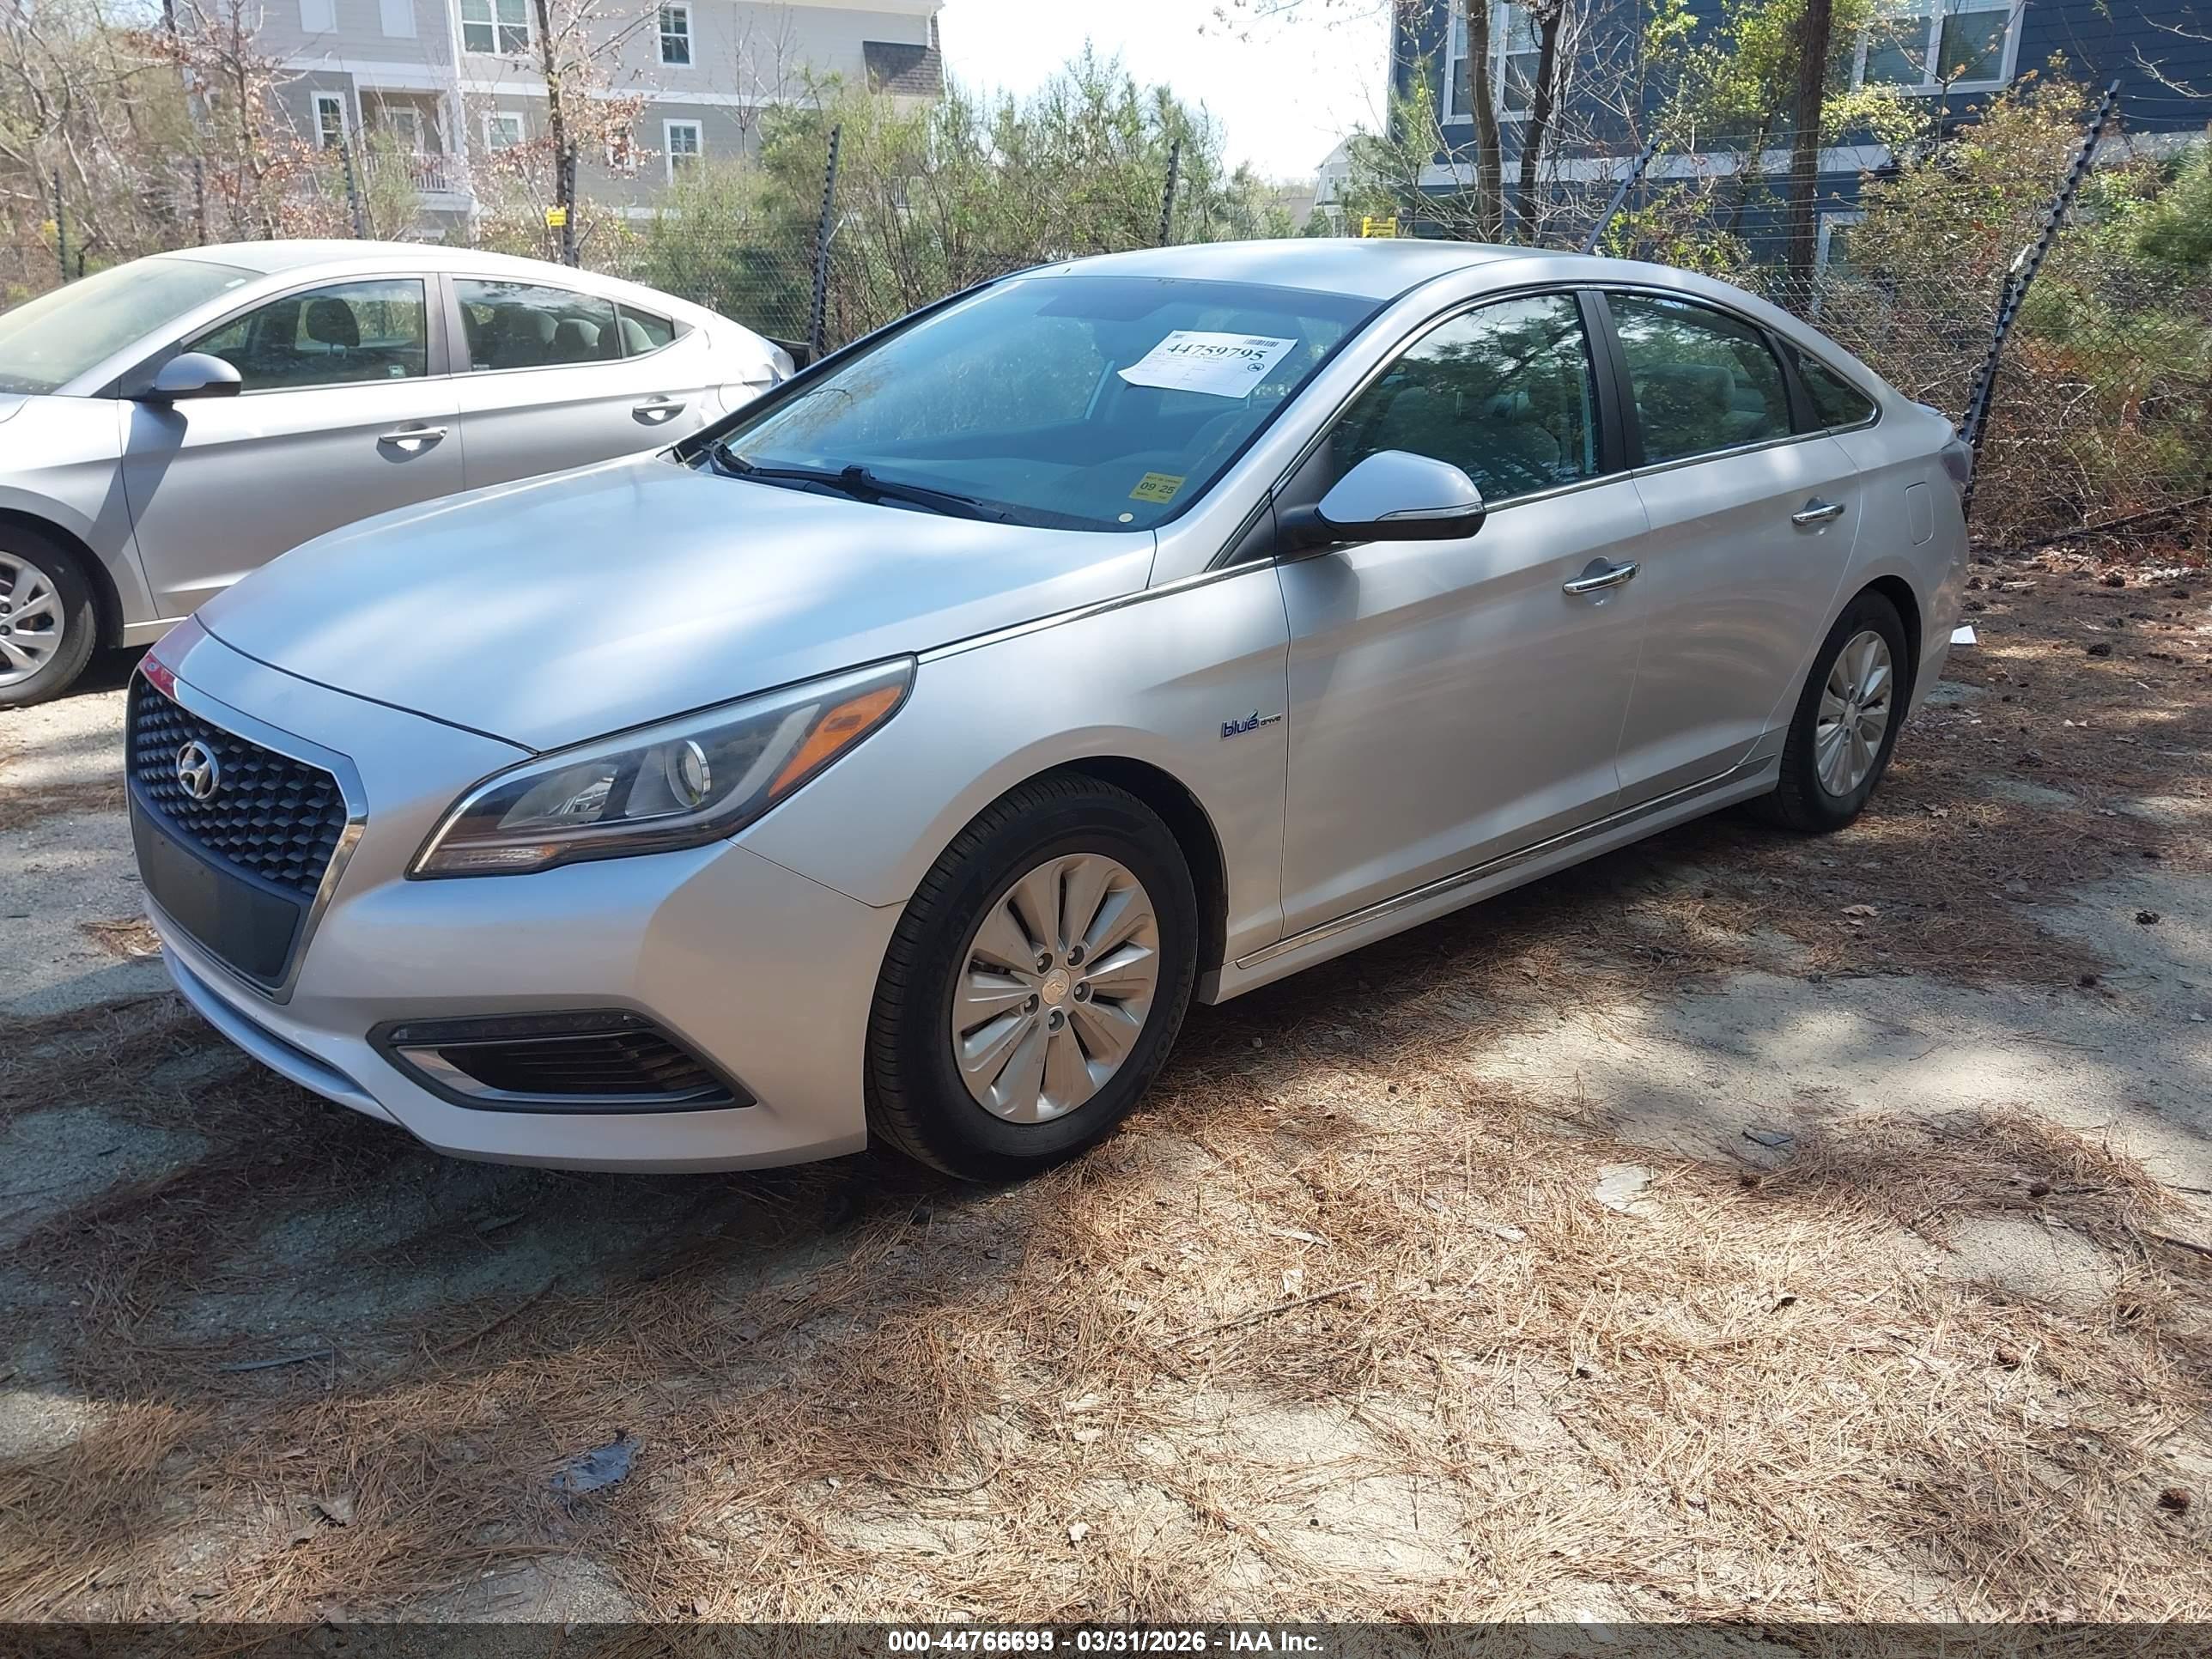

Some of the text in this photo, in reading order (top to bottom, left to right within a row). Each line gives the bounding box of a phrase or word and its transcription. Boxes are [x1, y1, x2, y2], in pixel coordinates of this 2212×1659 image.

[1167, 343, 1268, 361] 44759795
[1140, 482, 1156, 490] 09
[1158, 485, 1175, 494] 25
